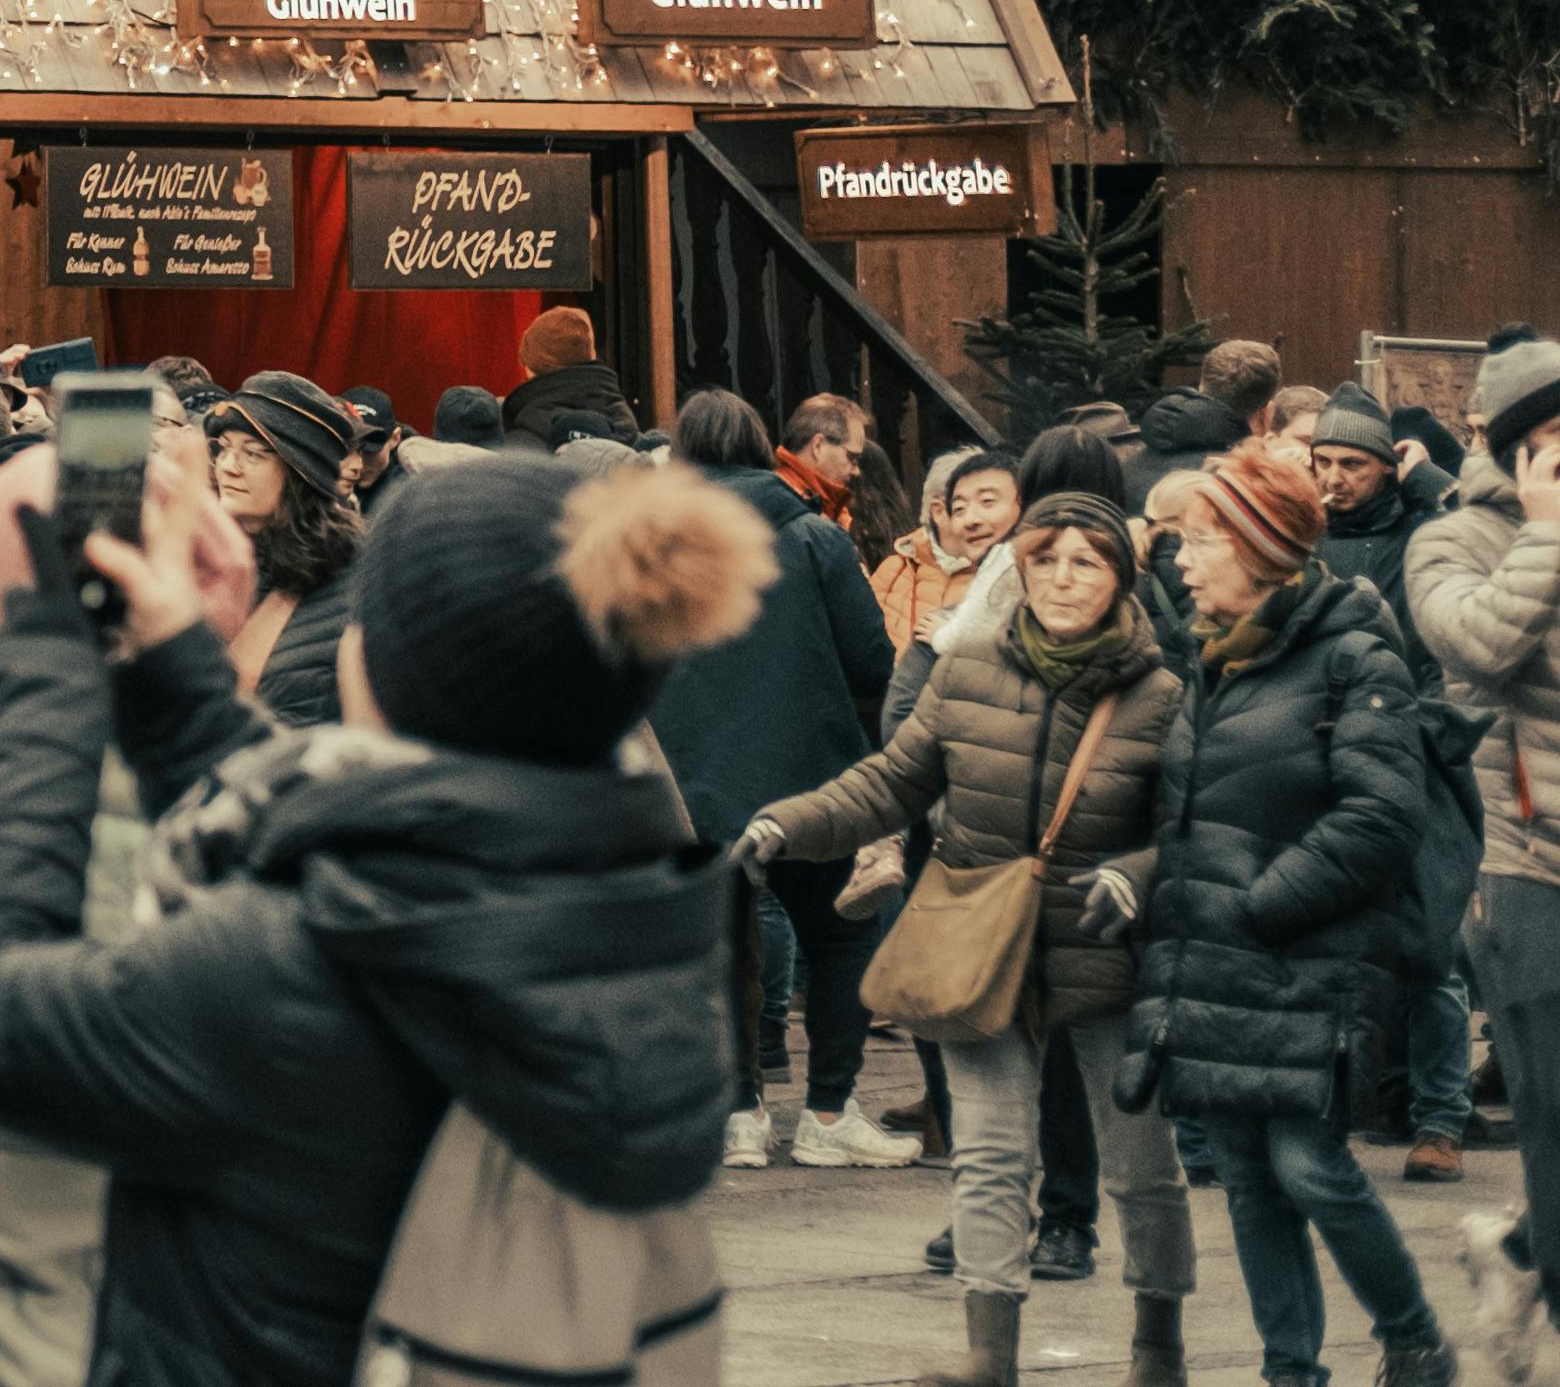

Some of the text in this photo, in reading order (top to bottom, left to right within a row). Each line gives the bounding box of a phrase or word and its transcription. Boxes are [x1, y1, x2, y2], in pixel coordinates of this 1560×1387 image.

[79, 149, 229, 203] GLÜHWEIN
[411, 168, 532, 215] PFAND-
[818, 158, 1011, 207] Pfandrückgabe
[383, 214, 558, 279] RÜCKGABE
